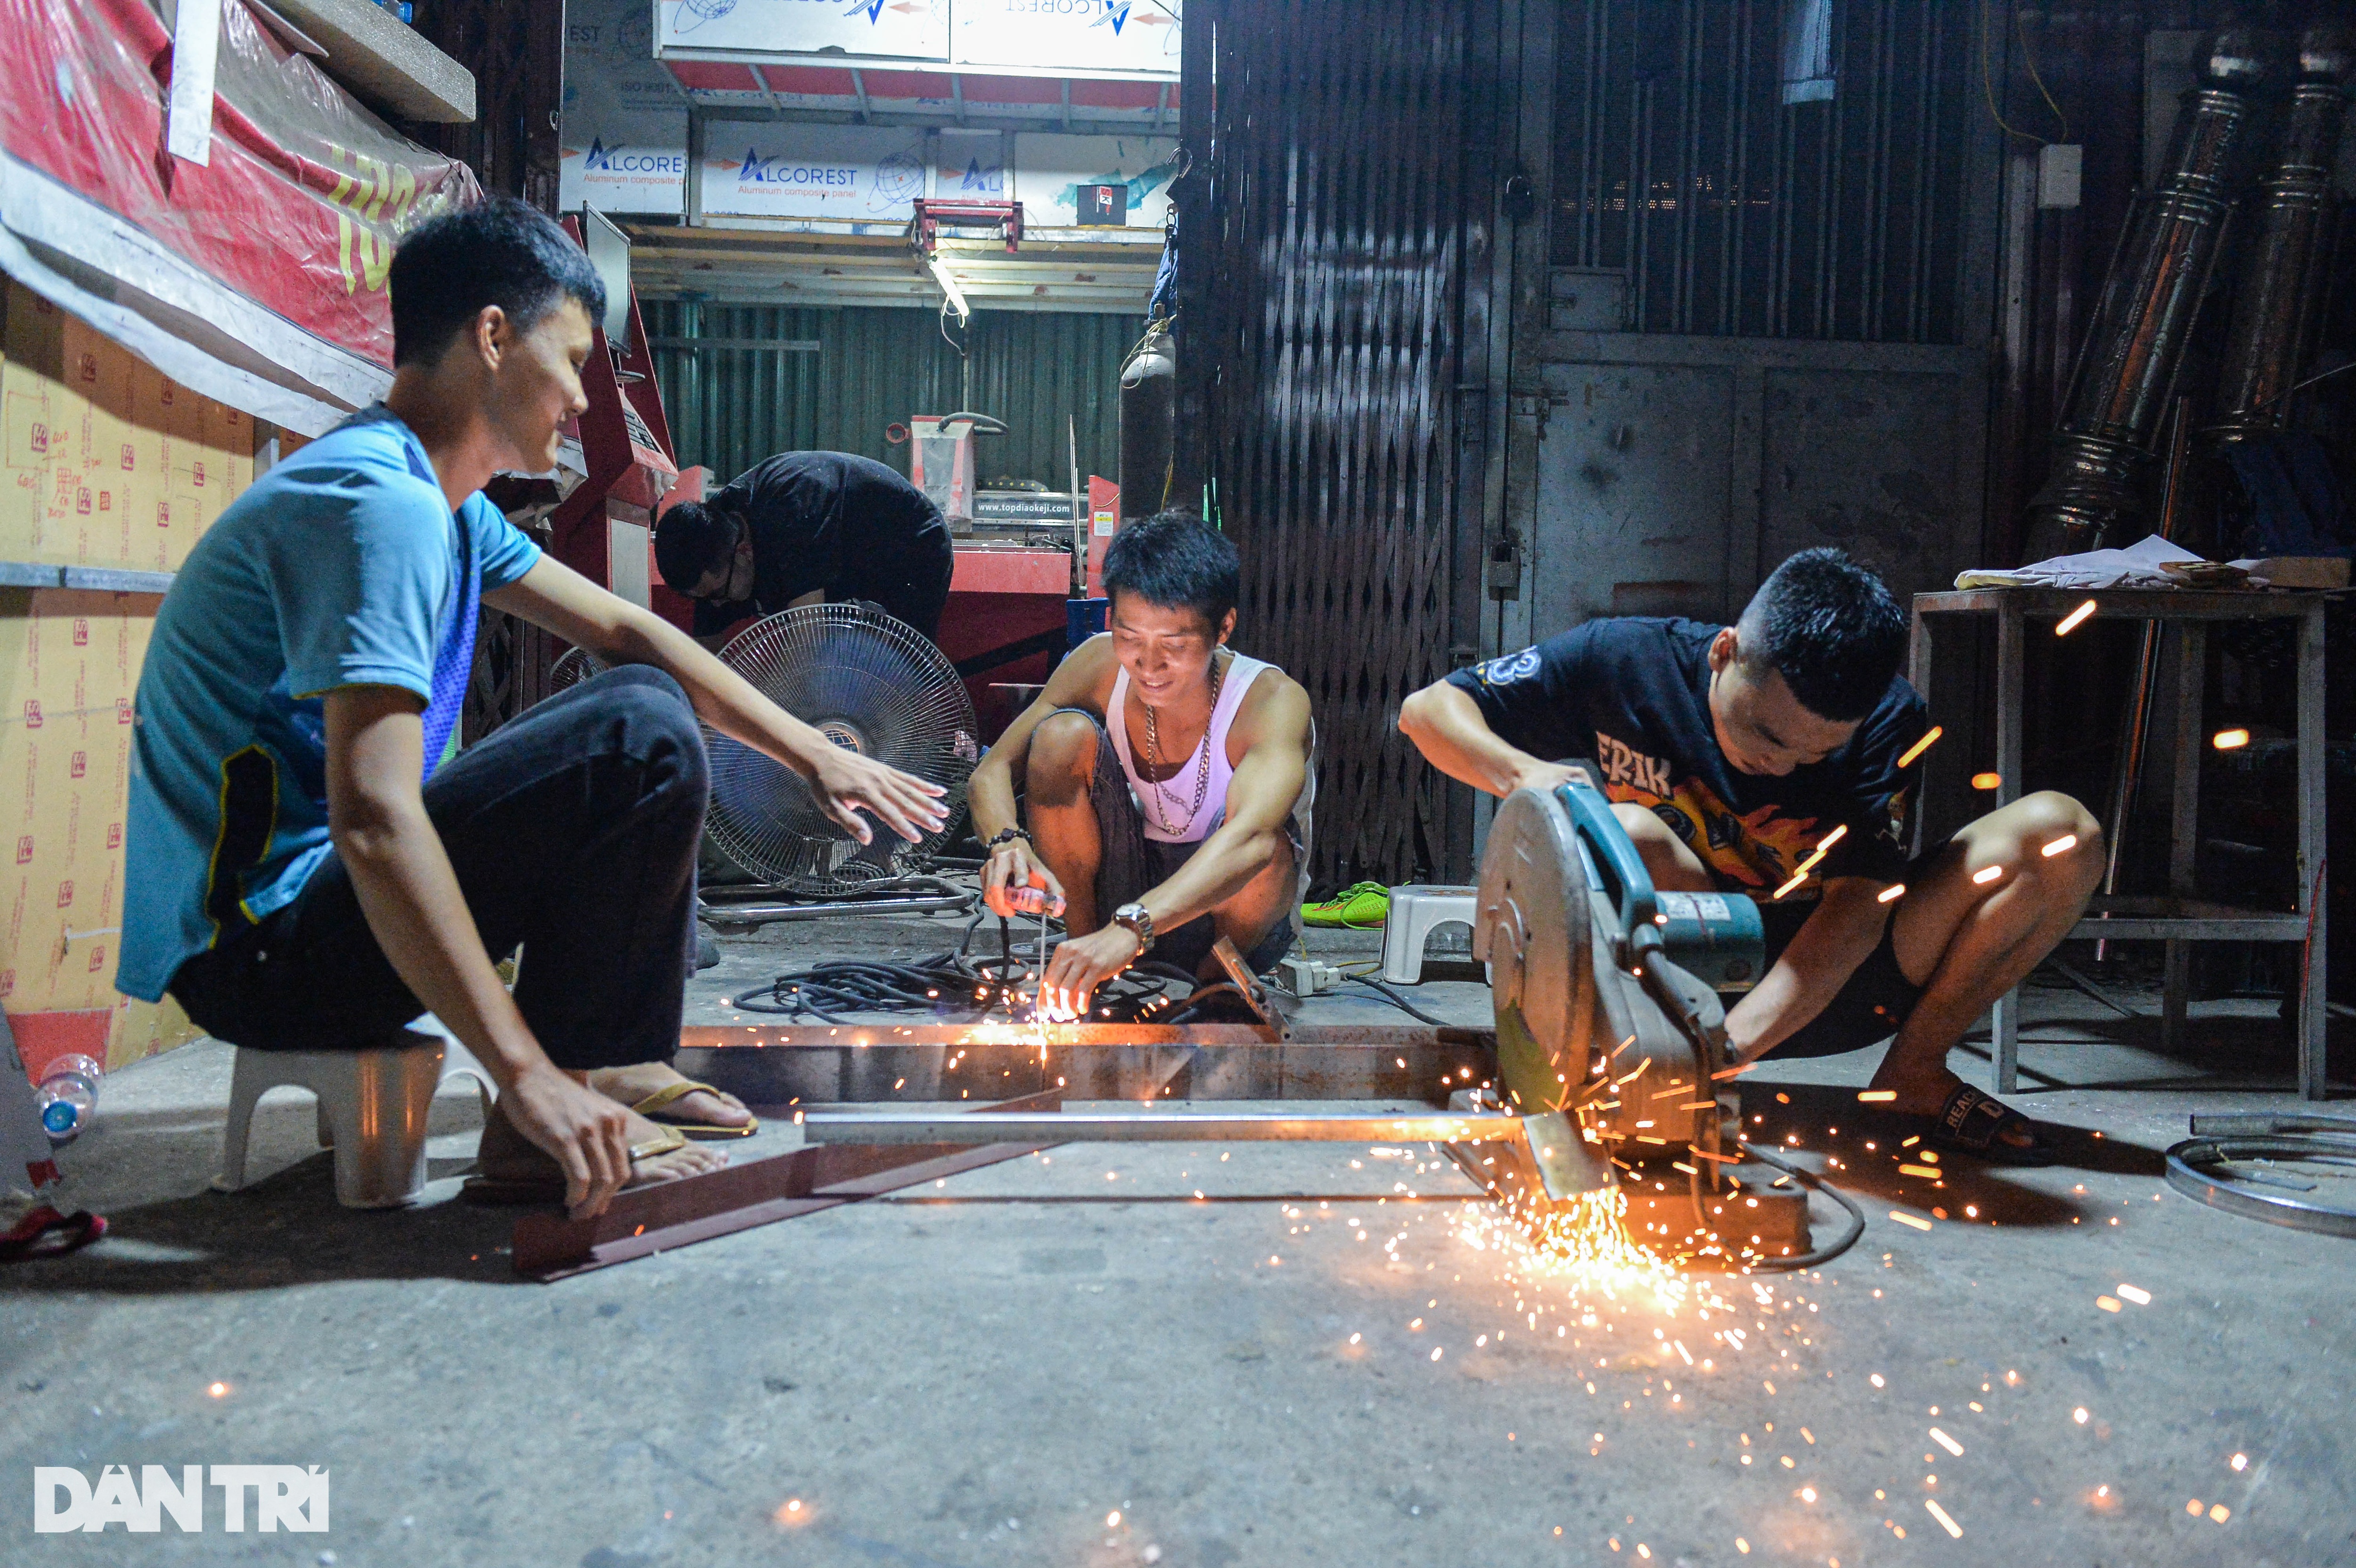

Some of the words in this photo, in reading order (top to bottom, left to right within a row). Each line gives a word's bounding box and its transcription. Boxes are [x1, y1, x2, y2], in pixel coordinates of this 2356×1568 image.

[584, 137, 686, 173] ALCORE
[738, 147, 857, 185] ALCOREST
[584, 173, 628, 183] Aluminum
[631, 175, 676, 185] composite
[738, 185, 781, 195] Aluminum
[785, 187, 829, 197] composite
[833, 189, 856, 198] panel
[123, 445, 134, 467] FS
[194, 463, 205, 483] FS
[79, 488, 91, 511] FS
[978, 503, 1070, 514] www.topdiaokeji.com
[158, 502, 169, 523] FS
[75, 619, 88, 642] FS
[72, 751, 86, 775] FS
[108, 824, 122, 846] FS
[18, 836, 33, 860] FS
[59, 880, 74, 905] FS
